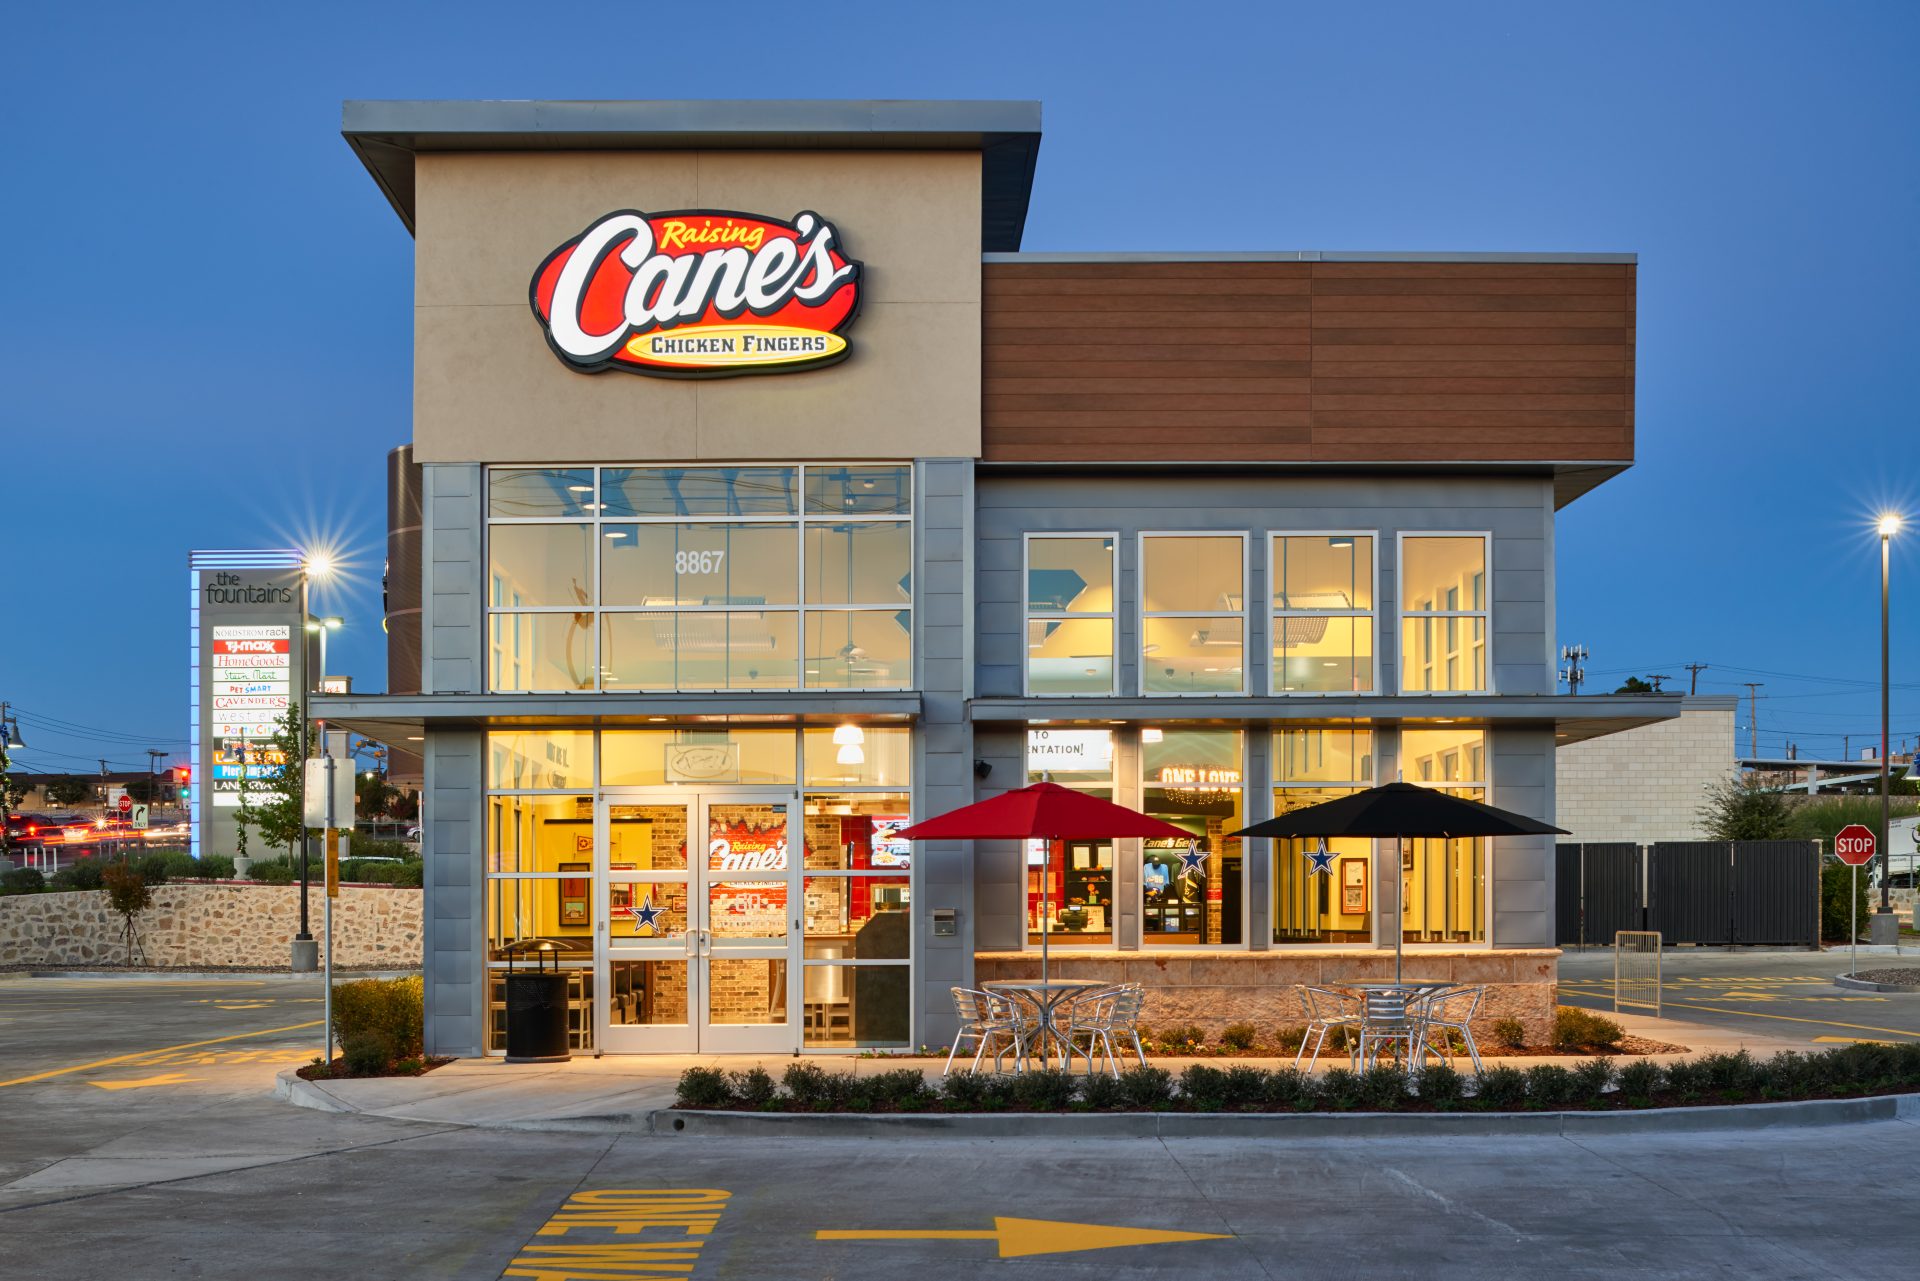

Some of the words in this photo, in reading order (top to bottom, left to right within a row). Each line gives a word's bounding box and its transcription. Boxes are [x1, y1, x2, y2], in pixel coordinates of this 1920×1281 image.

[659, 221, 765, 250] Raising
[549, 213, 853, 356] Cane's
[651, 336, 734, 354] CHICKEN
[742, 335, 826, 352] FINGERS
[675, 550, 725, 575] 8867
[216, 571, 240, 586] the
[205, 582, 292, 604] fountains
[215, 629, 264, 637] NORDSTROM
[265, 627, 287, 637] rack
[218, 655, 285, 667] HomeGoods
[219, 712, 251, 721] west
[1034, 730, 1049, 740] TO
[731, 841, 767, 852] Raising
[1174, 838, 1202, 848] Ger
[1838, 838, 1873, 853] STOP
[535, 1188, 734, 1236] ONE
